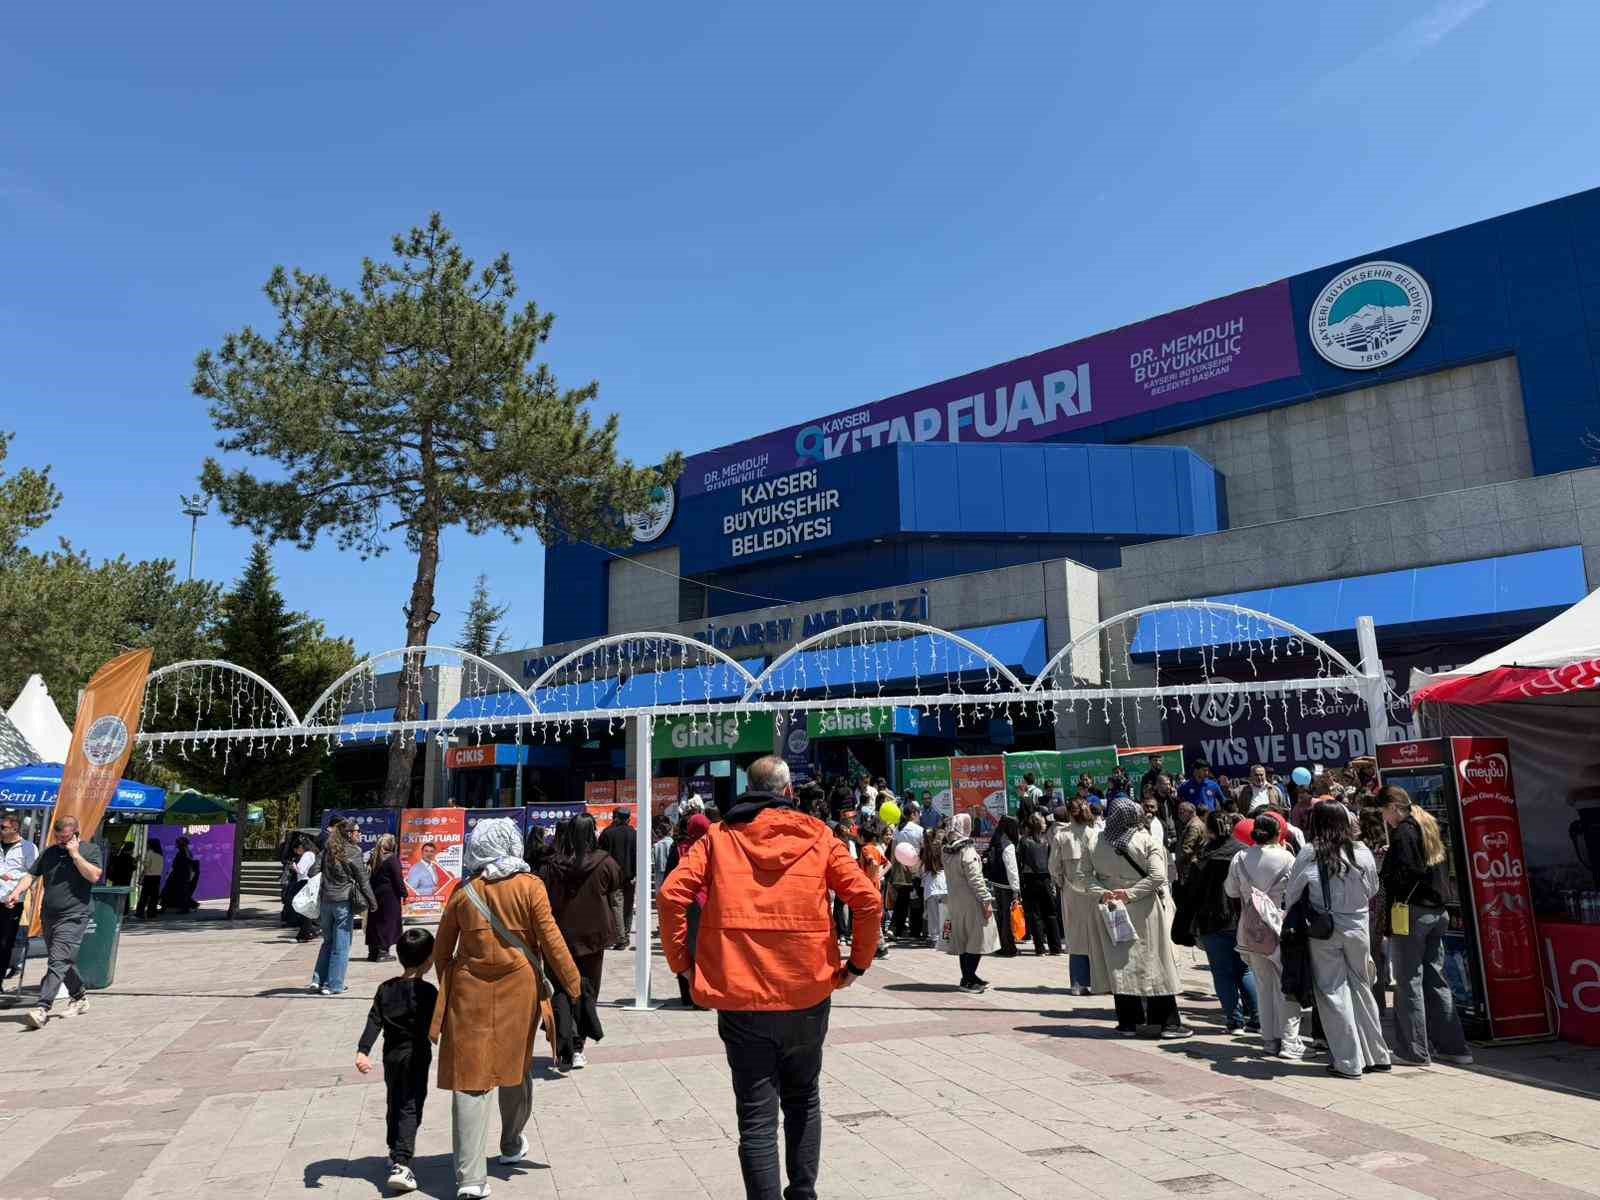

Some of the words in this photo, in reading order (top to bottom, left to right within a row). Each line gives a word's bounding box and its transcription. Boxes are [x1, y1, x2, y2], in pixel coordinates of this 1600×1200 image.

[1130, 348, 1158, 369] DR.
[1162, 317, 1244, 357] MEMDUH
[1134, 335, 1241, 383] BÜYÜKKILIÇ
[1360, 350, 1388, 362] 1869
[948, 362, 1092, 443] FUARI
[704, 470, 720, 485] DR.
[722, 453, 769, 479] MEMDUH
[1201, 738, 1249, 767] YKS
[1254, 734, 1287, 763] VE
[0, 789, 36, 801] Serin
[1473, 851, 1522, 879] Cola
